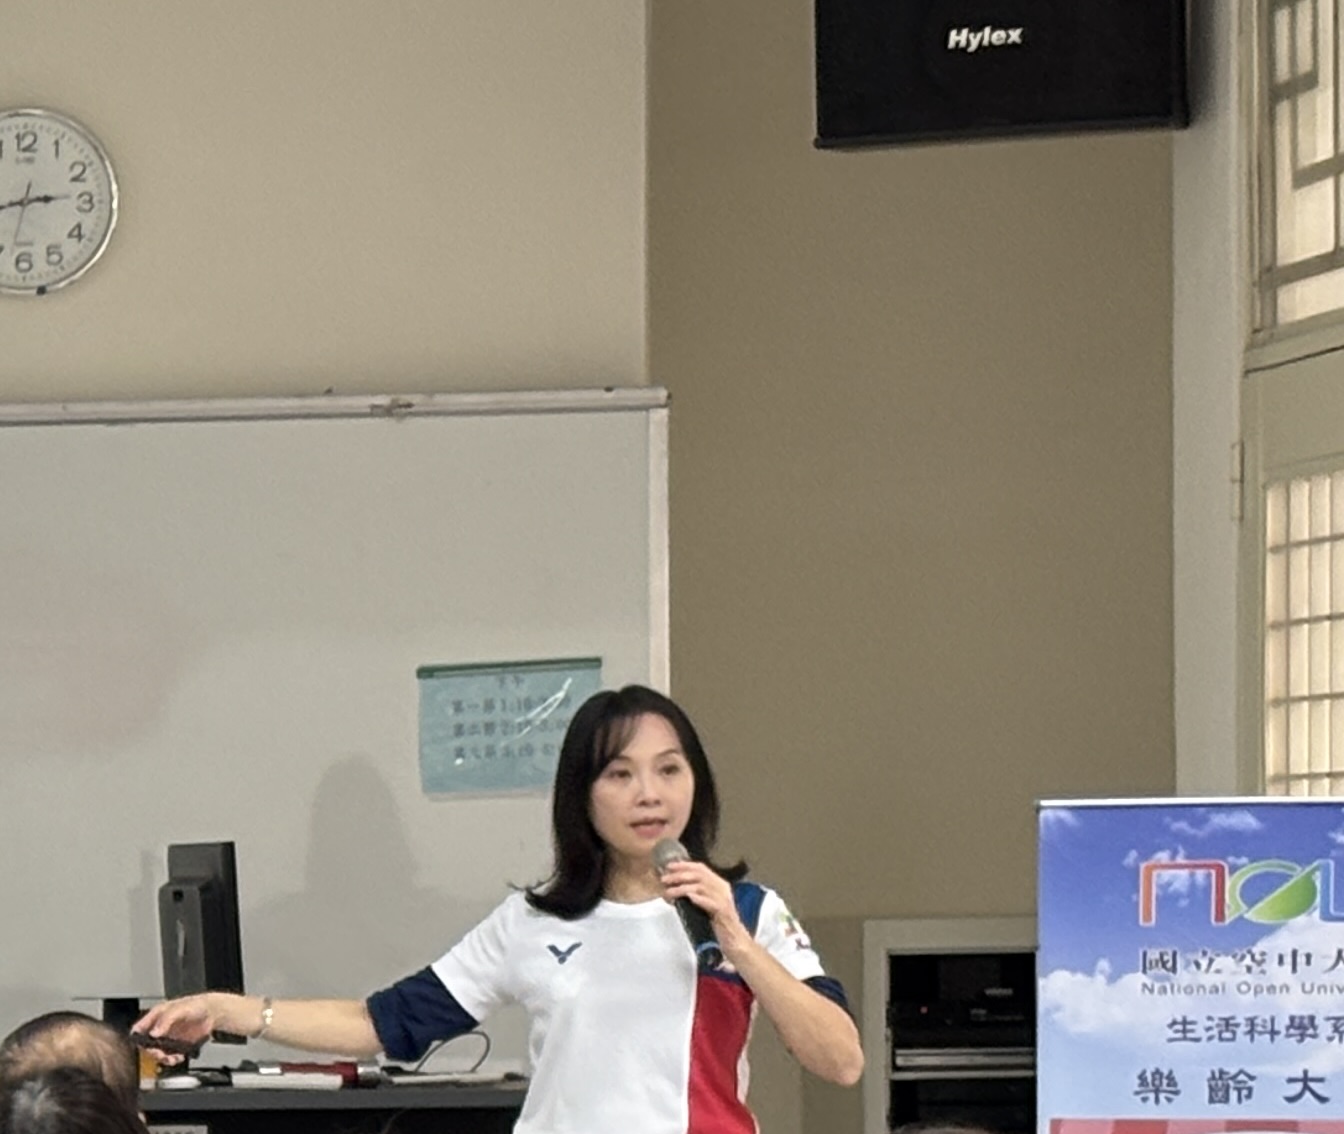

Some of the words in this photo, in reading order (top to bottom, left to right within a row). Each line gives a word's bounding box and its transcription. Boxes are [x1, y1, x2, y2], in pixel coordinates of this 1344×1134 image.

[947, 25, 1023, 53] Hylex
[15, 131, 38, 154] 12
[53, 139, 60, 159] 1
[69, 161, 87, 183] 2
[76, 191, 95, 214] 3
[67, 222, 86, 243] 4
[14, 252, 33, 273] 6
[46, 244, 64, 266] 5
[1141, 981, 1226, 996] National
[1236, 981, 1291, 997] Open
